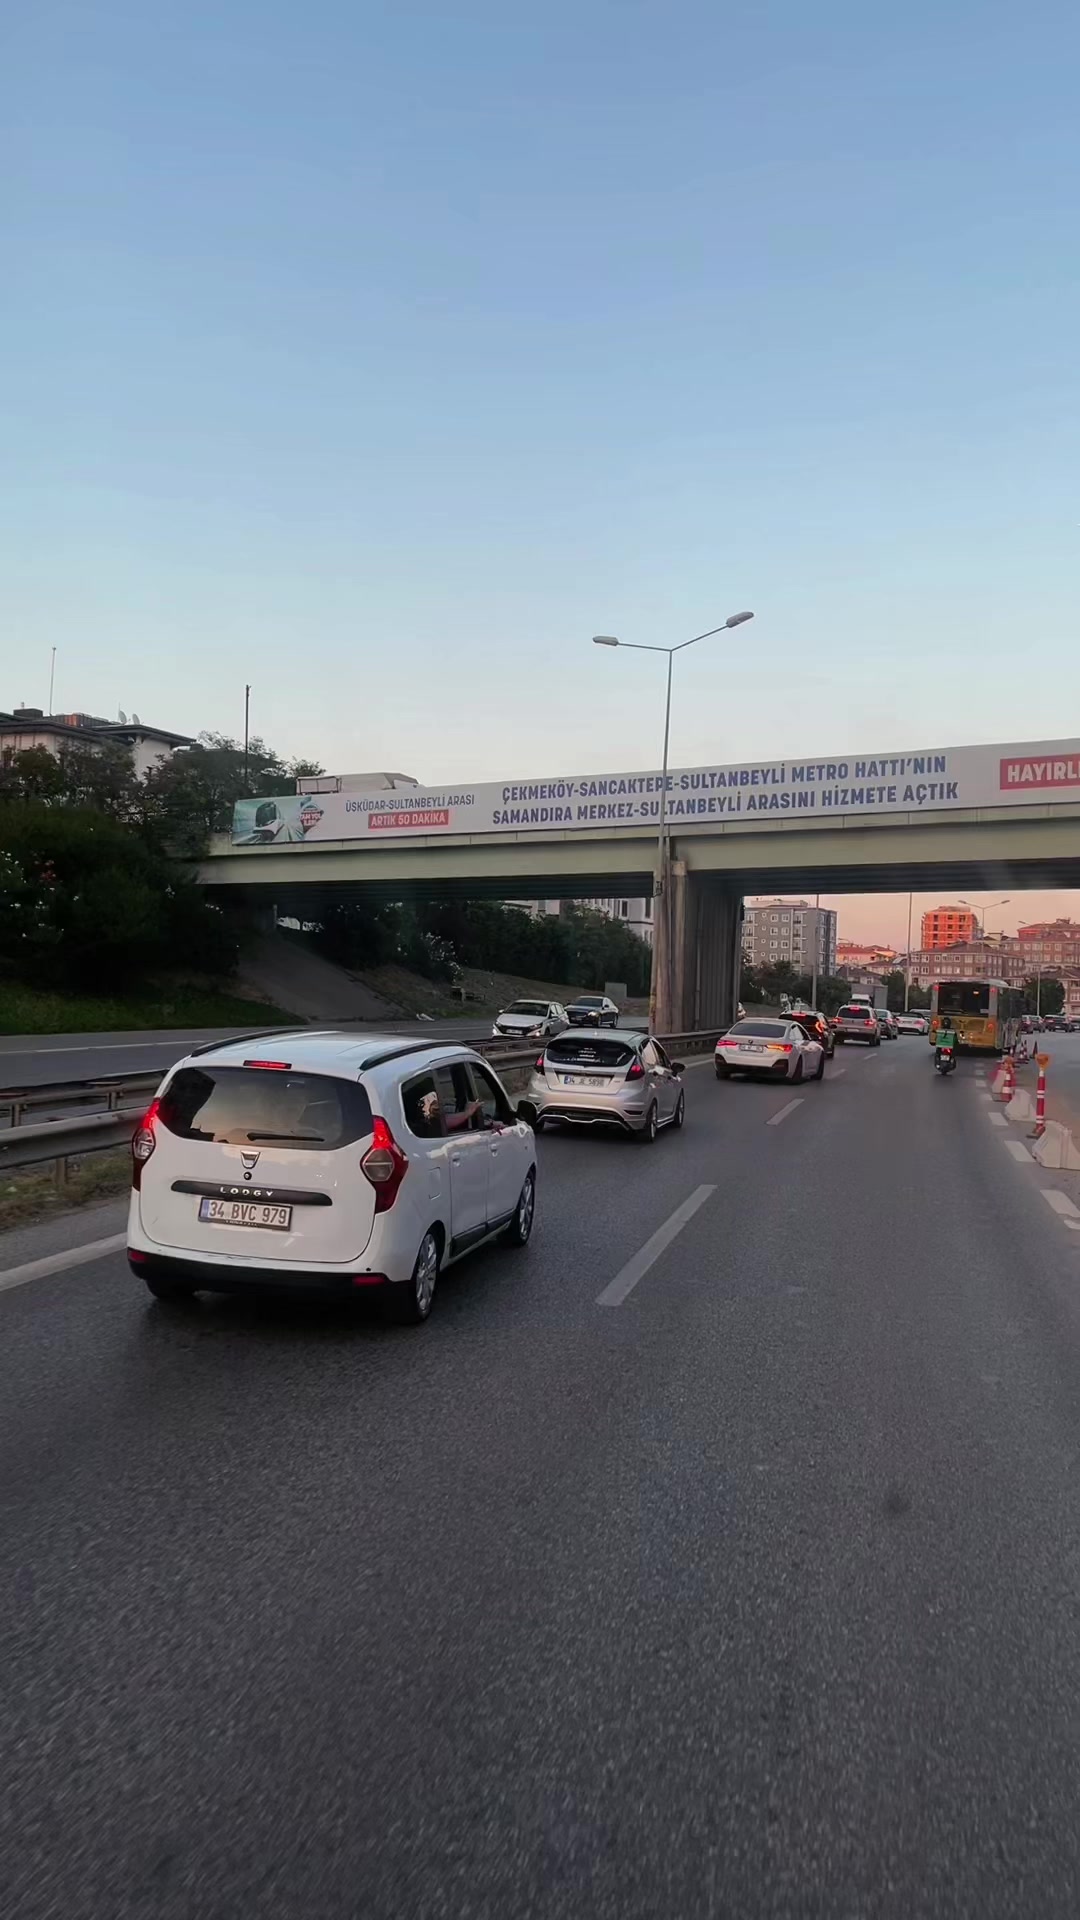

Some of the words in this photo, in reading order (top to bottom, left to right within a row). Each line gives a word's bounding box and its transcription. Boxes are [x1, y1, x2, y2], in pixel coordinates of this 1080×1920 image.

[502, 763, 785, 804] ÇEKMEKÖY-SANCAKTEPE-SULTANBEYLİ
[791, 763, 849, 783] METRO
[855, 756, 946, 778] HATTI'NIN
[345, 793, 446, 812] ÜSKÜDAR-SULTANBEYLİ
[447, 794, 475, 806] ARASI
[492, 806, 573, 825] SAMANDIRA
[746, 790, 816, 812] ARASINI
[821, 784, 897, 807] HİZMETE
[903, 781, 959, 805] AÇTIK
[371, 815, 396, 827] ARTIK
[398, 814, 410, 825] 50
[219, 1186, 274, 1196] LODGY
[209, 1201, 225, 1218] 34
[231, 1203, 257, 1221] BVC
[262, 1207, 287, 1225] 979
